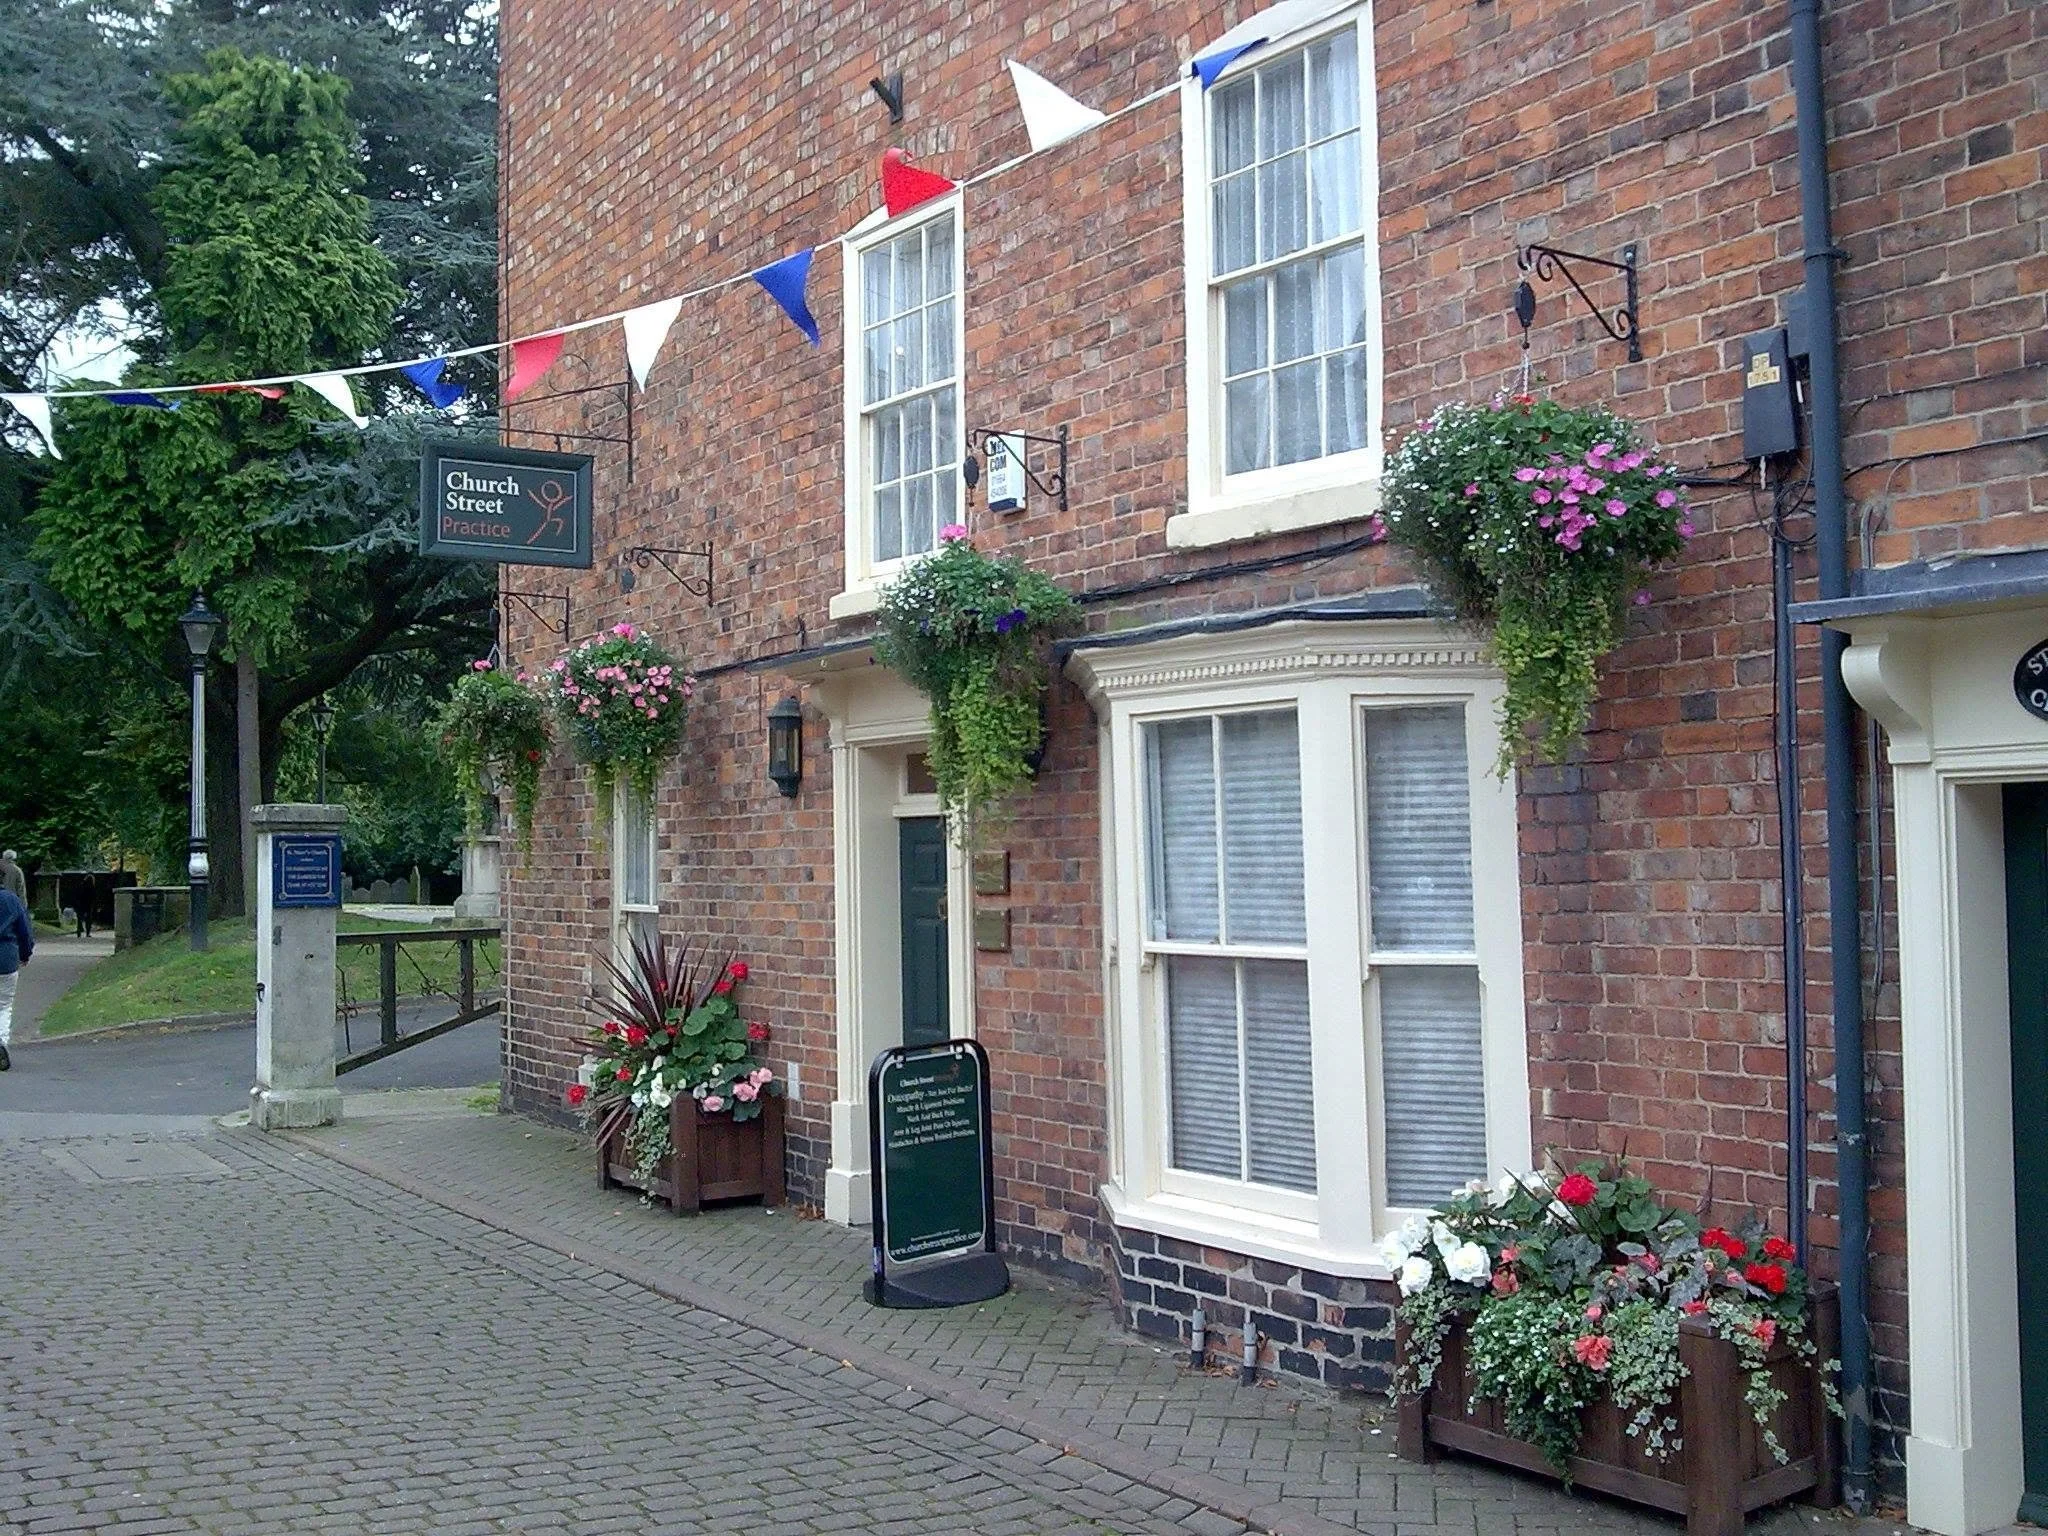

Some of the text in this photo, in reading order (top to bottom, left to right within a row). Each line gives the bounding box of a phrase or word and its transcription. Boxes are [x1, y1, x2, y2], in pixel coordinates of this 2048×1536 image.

[446, 471, 520, 496] Church
[446, 491, 504, 515] Street
[441, 516, 511, 538] Practice
